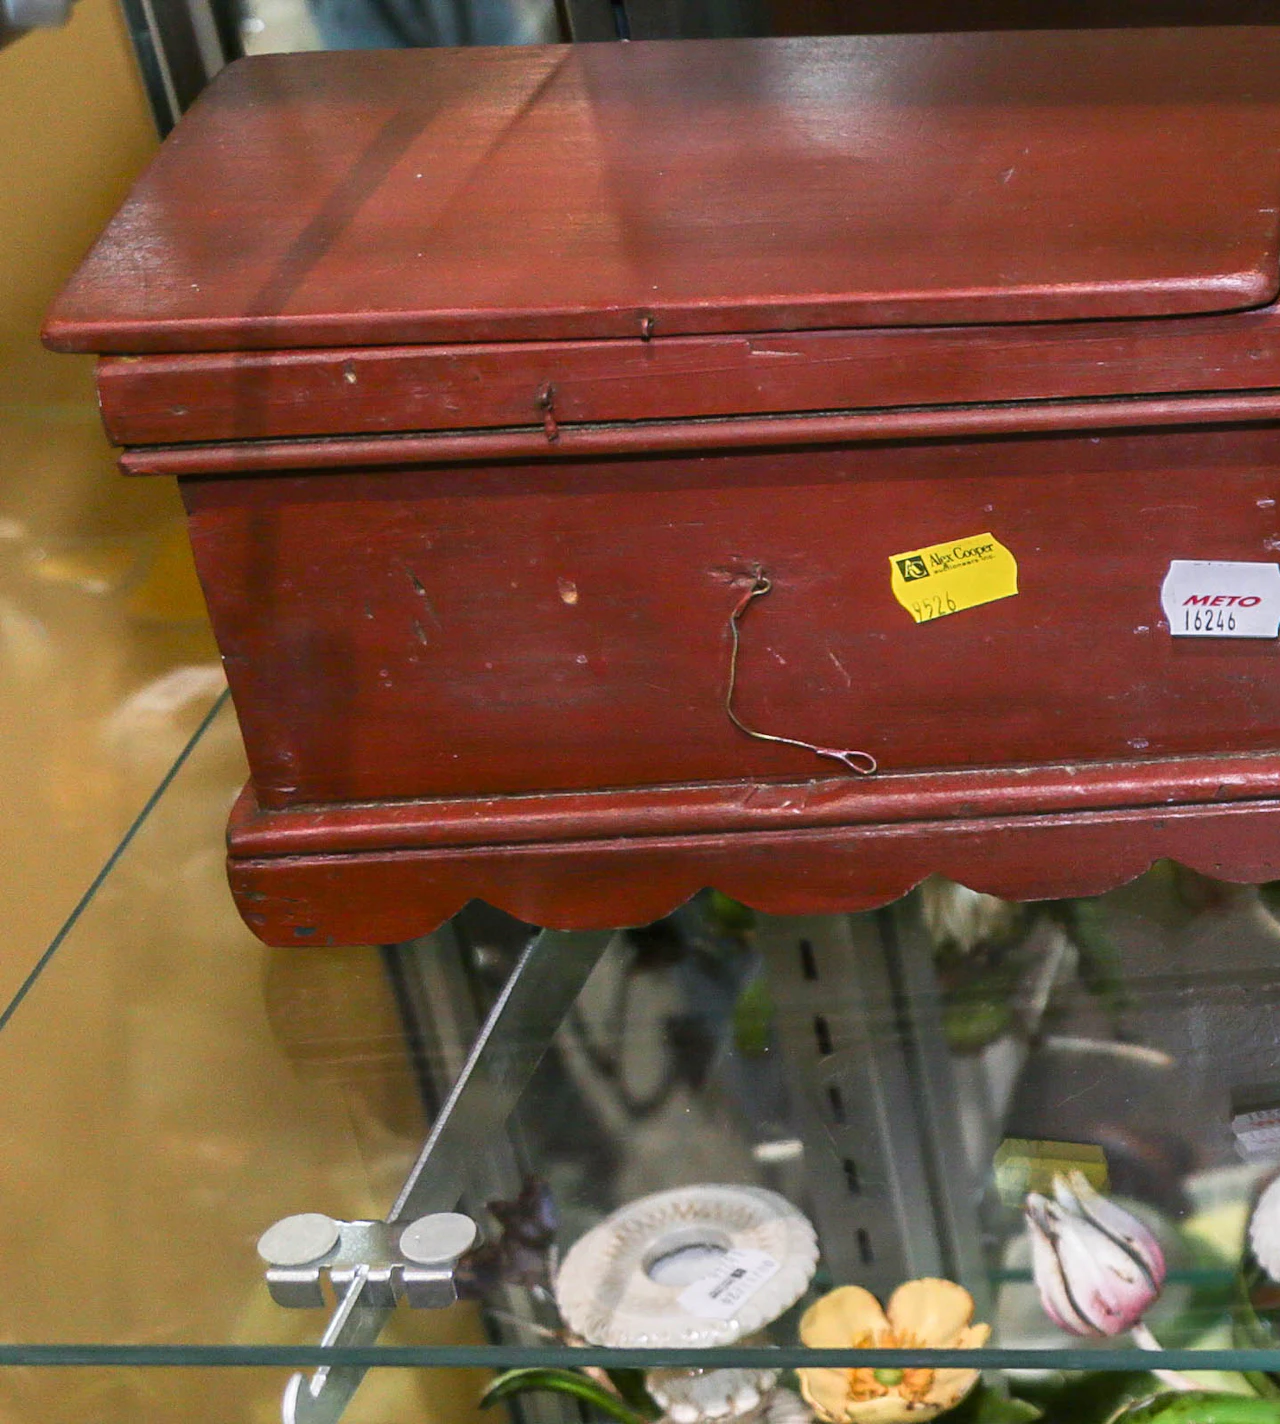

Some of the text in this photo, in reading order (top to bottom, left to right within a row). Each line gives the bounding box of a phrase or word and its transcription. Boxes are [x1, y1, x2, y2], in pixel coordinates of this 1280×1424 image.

[930, 544, 993, 567] Alex Cooper
[1182, 594, 1262, 608] METO
[1184, 609, 1237, 631] 16246
